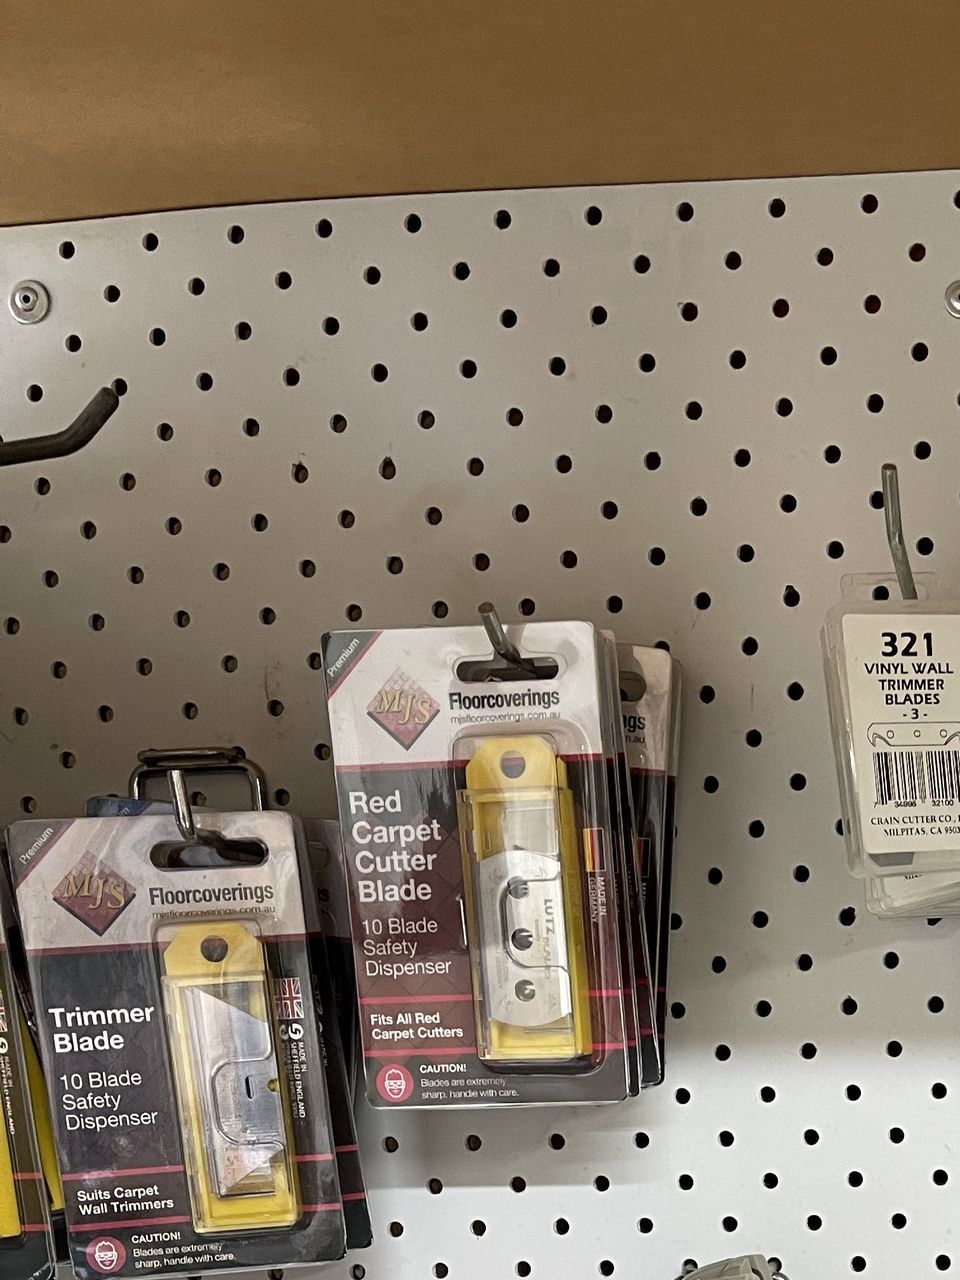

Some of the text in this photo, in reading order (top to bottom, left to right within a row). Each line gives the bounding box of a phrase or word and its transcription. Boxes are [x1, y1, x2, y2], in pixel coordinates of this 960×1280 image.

[881, 632, 933, 657] 321
[327, 638, 360, 677] Premium
[864, 663, 954, 674] VINYL WALL
[878, 679, 944, 691] TRIMMER
[376, 688, 431, 725] MJS
[449, 689, 560, 710] Floorcoverings
[885, 693, 940, 705] BLADES
[450, 711, 560, 725] mjsfloorcoverings.com.au
[349, 790, 402, 814] Red
[870, 816, 900, 825] CRAIN
[902, 815, 937, 824] CUTTER
[352, 819, 442, 847] Carpet
[930, 827, 942, 835] CA
[19, 826, 54, 864] Premium
[355, 850, 437, 873] Cutter
[62, 871, 126, 910] MJS
[149, 883, 274, 906] Floorcoverings
[358, 879, 432, 902] Blade
[597, 876, 606, 904] MADE
[589, 877, 599, 923] GERMANY
[362, 917, 438, 935] 10 Blade
[544, 899, 555, 935] LUTZ
[363, 939, 417, 958] Safety
[366, 960, 452, 979] Dispenser
[48, 1006, 155, 1027] Trimmer
[370, 1012, 440, 1025] Fits All Red
[54, 1031, 125, 1053] Blade
[372, 1026, 463, 1041] Carpet Cutters
[298, 1042, 307, 1072] MADE IN
[419, 1064, 467, 1074] CAUTION!
[60, 1070, 142, 1090] 10 Blade
[291, 1042, 306, 1118] SHEFFIELD ENGLAND
[421, 1078, 507, 1087] Blades are extremely
[62, 1093, 121, 1111] Safety
[480, 1089, 497, 1097] with
[499, 1089, 519, 1097] care.
[65, 1112, 158, 1132] Dispenser
[77, 1185, 160, 1202] Suits Carpet
[79, 1198, 174, 1216] Wall Trimmers
[131, 1231, 181, 1244] CAUTION!
[133, 1242, 224, 1257] Blades are extremely
[135, 1252, 236, 1269] sharp, handle with care.
